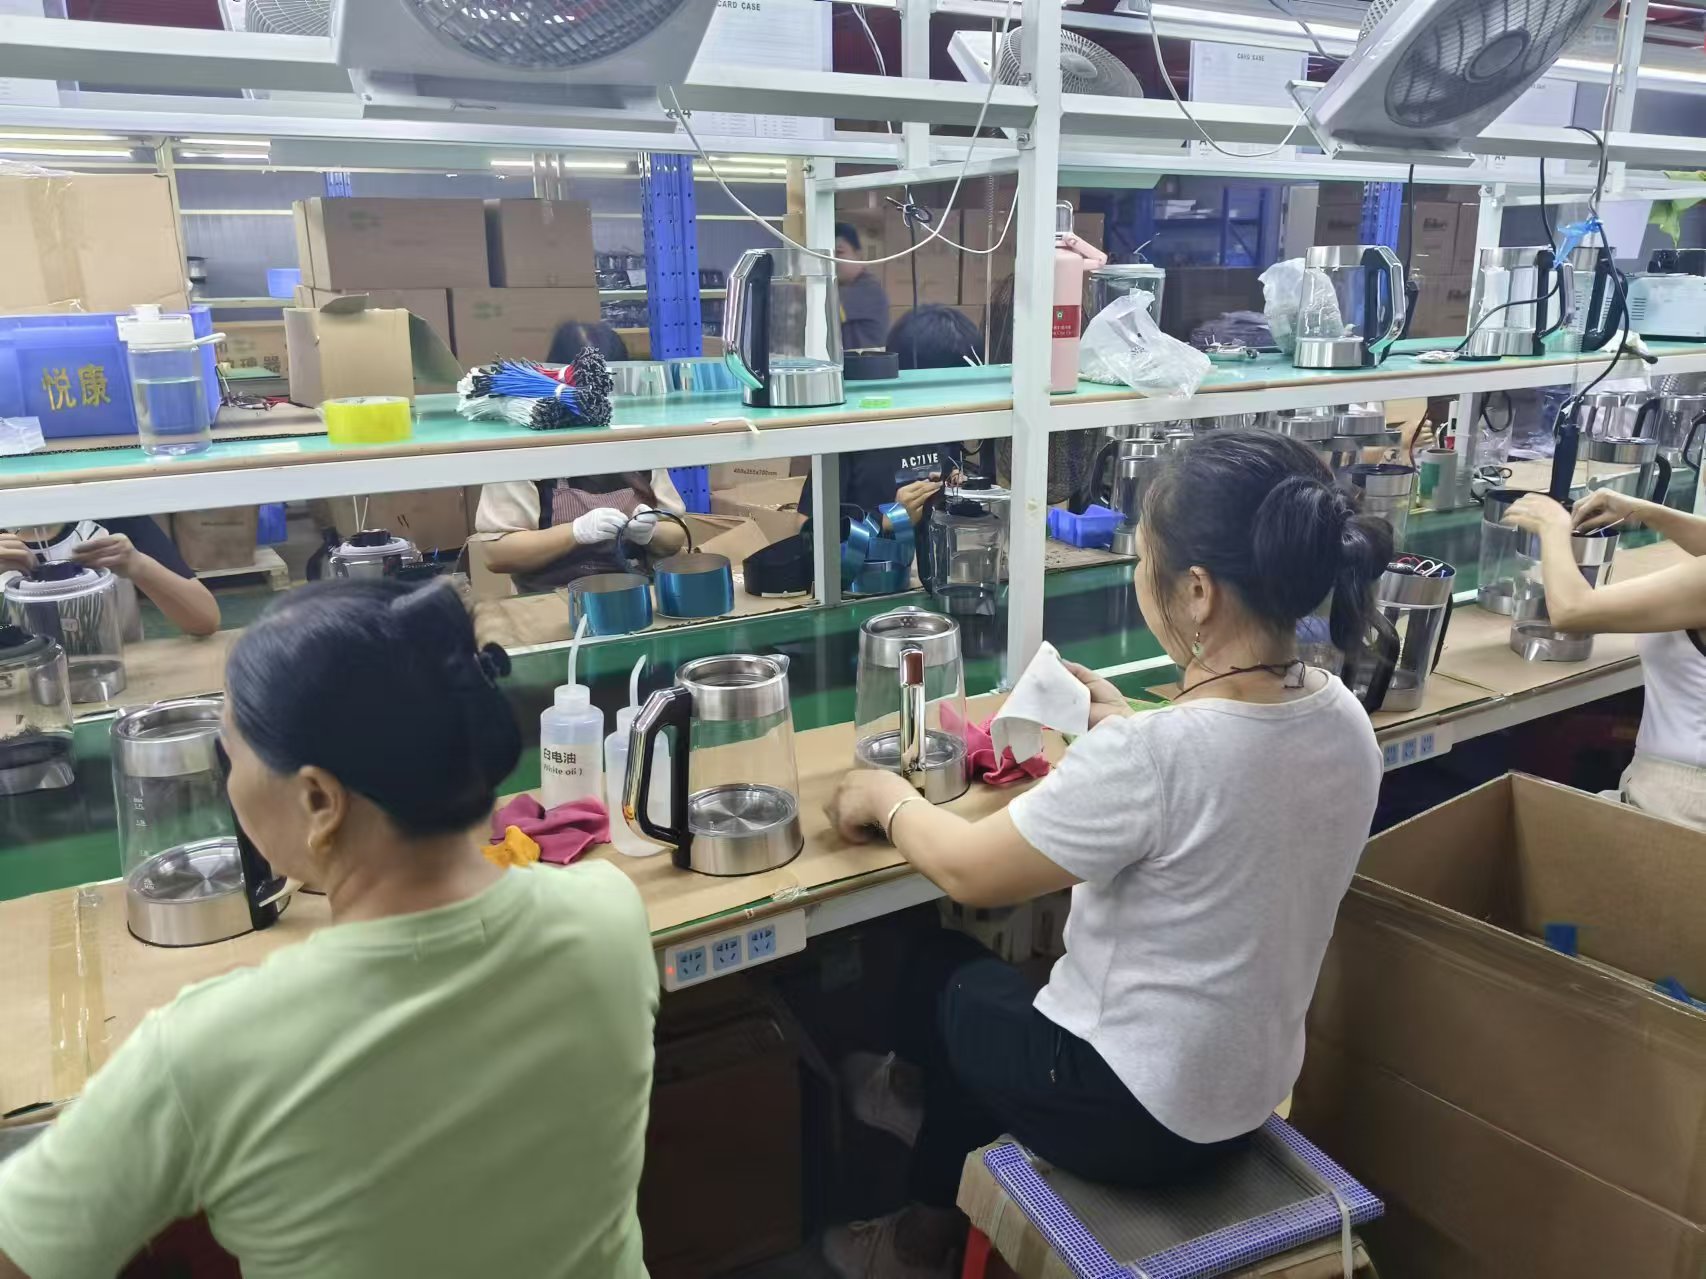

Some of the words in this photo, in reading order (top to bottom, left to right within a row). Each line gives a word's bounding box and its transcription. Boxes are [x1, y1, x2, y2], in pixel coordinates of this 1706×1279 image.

[741, 2, 761, 11] CASE
[42, 363, 111, 411] 悦康
[901, 453, 939, 469] ACTIVE
[543, 748, 577, 765] 白电油
